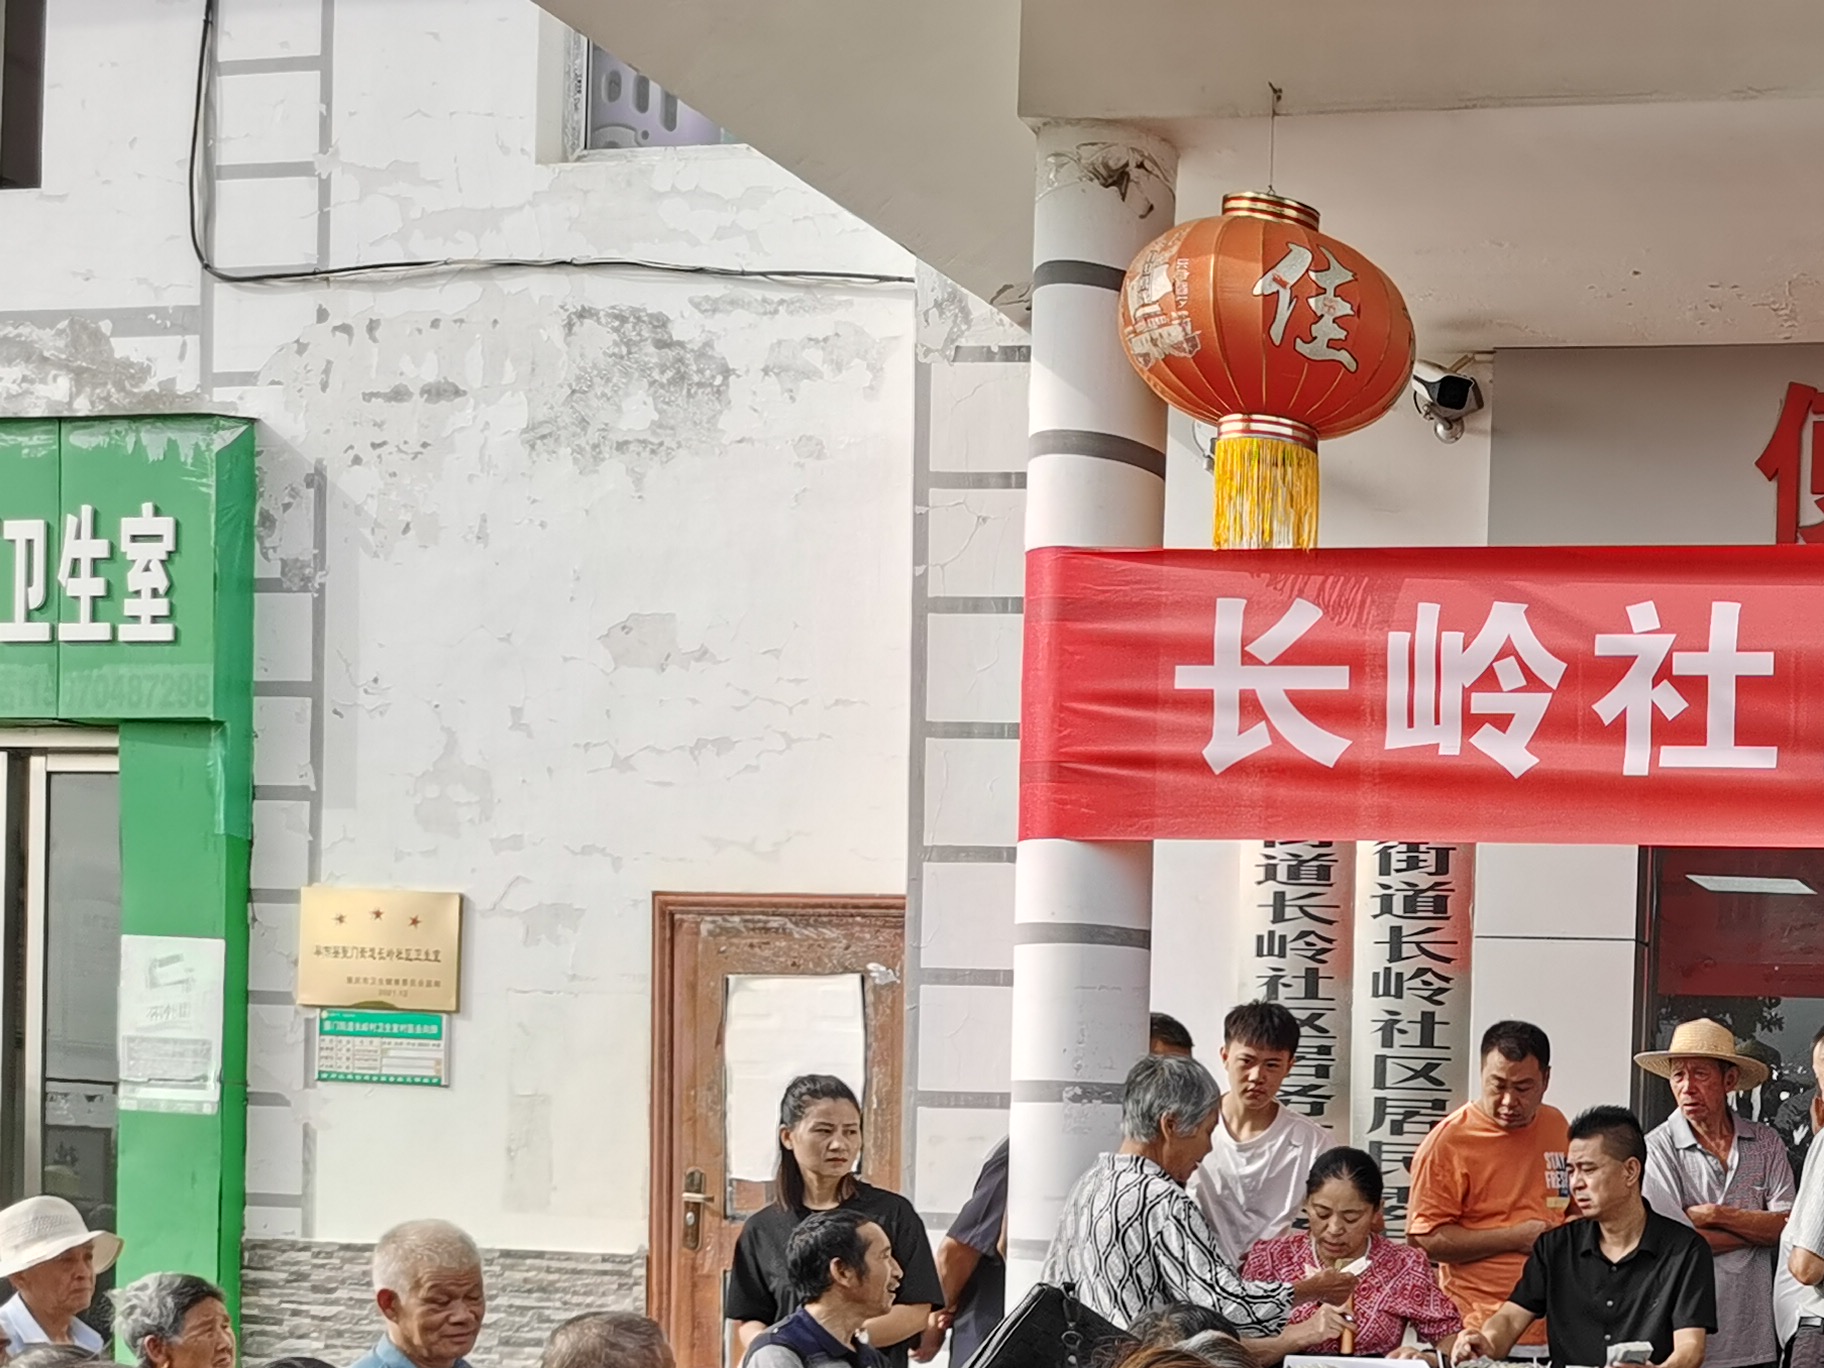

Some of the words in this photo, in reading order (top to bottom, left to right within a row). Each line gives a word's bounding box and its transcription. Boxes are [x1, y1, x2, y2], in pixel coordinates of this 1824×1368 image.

[1252, 242, 1358, 373] 佳
[0, 502, 178, 643] 卫生室
